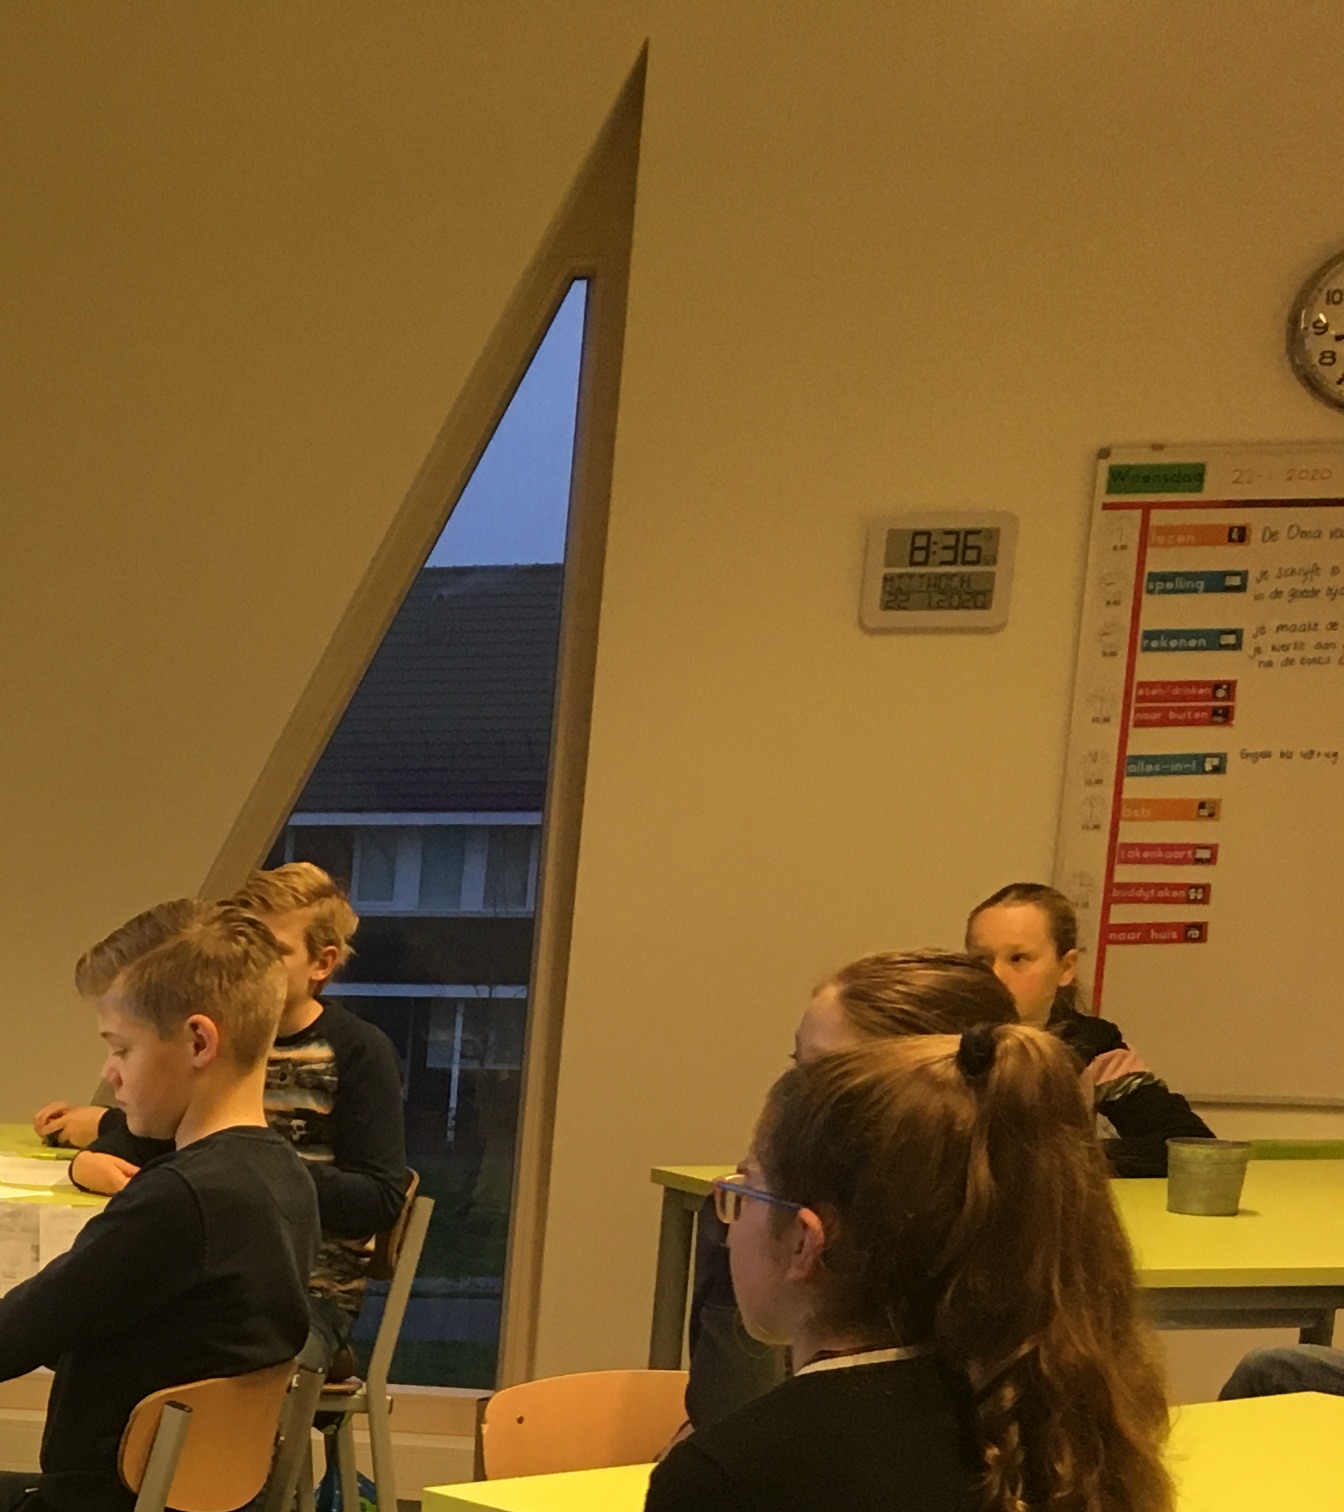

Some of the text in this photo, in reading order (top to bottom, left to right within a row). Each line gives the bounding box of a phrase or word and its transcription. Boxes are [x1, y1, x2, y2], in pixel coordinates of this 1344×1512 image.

[1325, 289, 1343, 305] 10
[1312, 317, 1329, 336] 9
[1318, 350, 1337, 367] 8
[1287, 523, 1322, 541] Oma
[909, 530, 982, 567] 8:36
[1148, 577, 1205, 593] spelling
[1143, 635, 1207, 648] rekenen
[1112, 887, 1186, 900] buddytaken
[1109, 928, 1178, 941] naar huis
